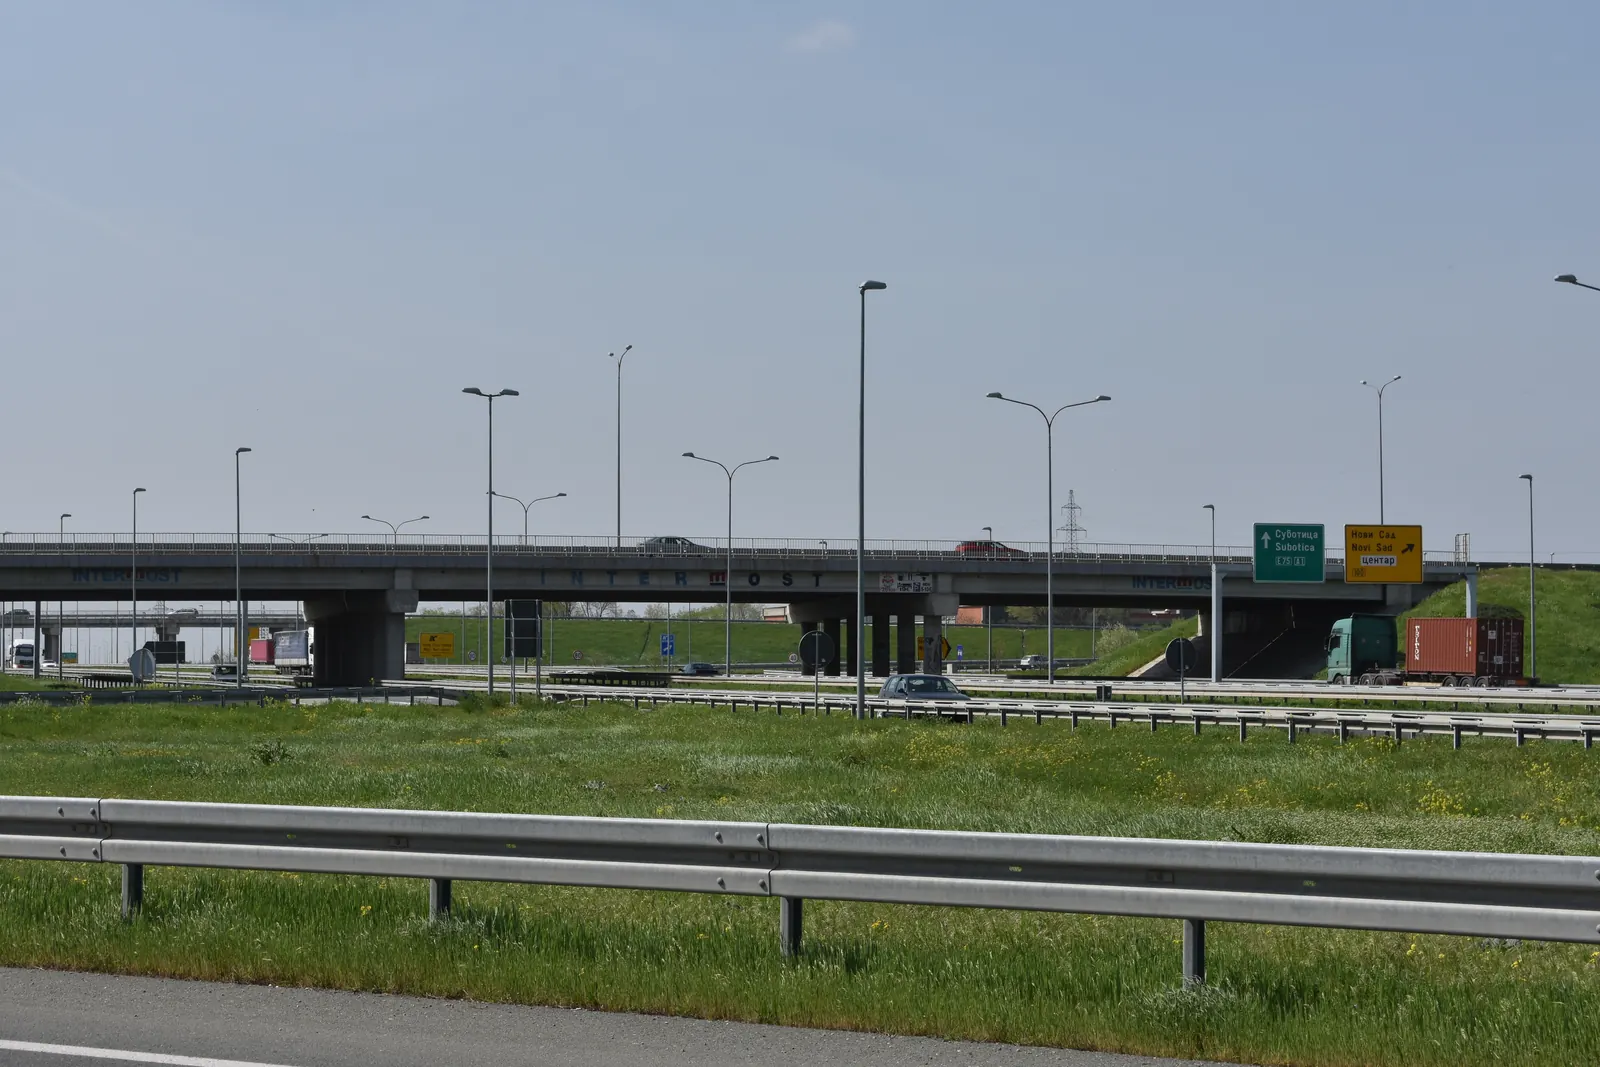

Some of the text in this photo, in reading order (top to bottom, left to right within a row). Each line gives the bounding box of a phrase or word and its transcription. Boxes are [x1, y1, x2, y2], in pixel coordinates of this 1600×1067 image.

[1275, 529, 1319, 540] Суботица
[1351, 530, 1397, 539] Нови Сад
[1275, 542, 1315, 552] Subotica
[1352, 543, 1393, 552] Novi Sad
[1276, 557, 1305, 565] E75 A1
[1362, 556, 1396, 566] центар
[1132, 575, 1212, 589] INTERMOS
